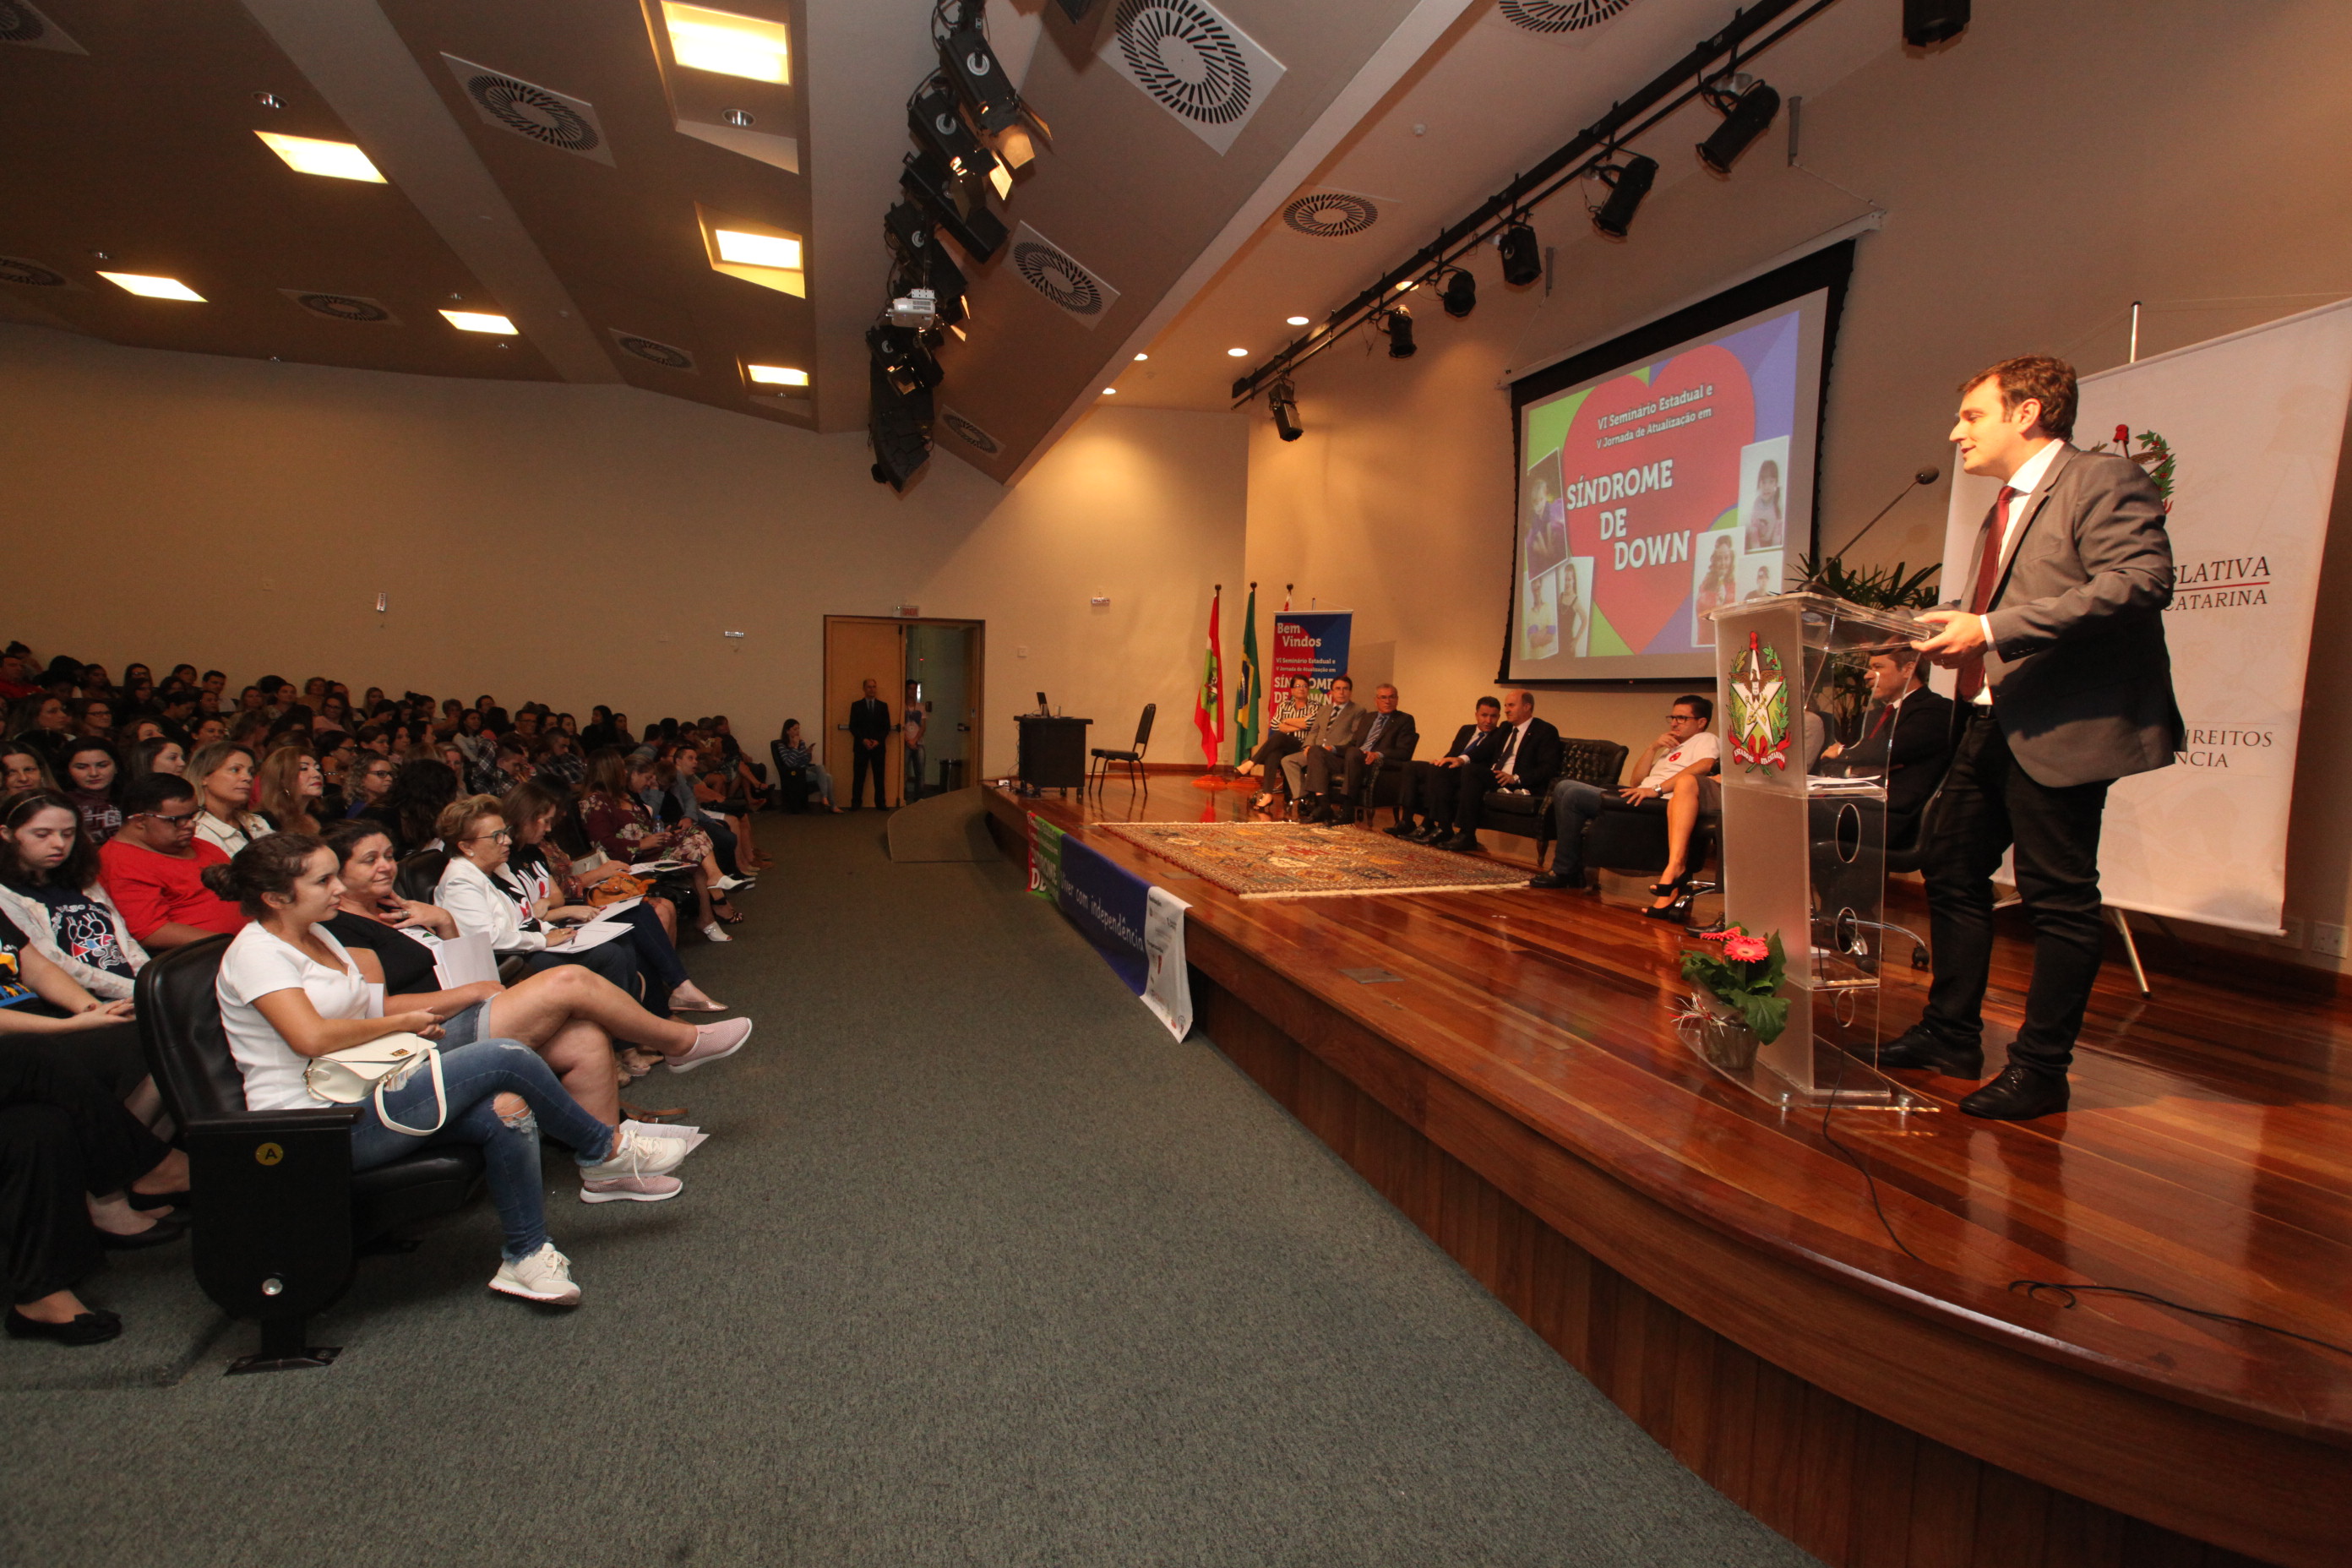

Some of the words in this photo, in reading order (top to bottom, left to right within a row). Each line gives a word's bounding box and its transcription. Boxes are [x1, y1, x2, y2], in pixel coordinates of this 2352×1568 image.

[1598, 416, 1607, 430] VI
[1609, 402, 1657, 427] Seminário
[1658, 384, 1703, 411] Estadual
[1706, 385, 1712, 395] e
[1596, 438, 1603, 449] V
[1603, 430, 1634, 447] Jornada
[1636, 427, 1645, 438] de
[1647, 413, 1696, 434] Atualização
[1697, 408, 1712, 419] em
[1566, 459, 1673, 510] SÍNDROME
[1599, 508, 1627, 540] DE
[1614, 530, 1690, 570] DOWN
[2173, 556, 2270, 585] LATIVA
[1277, 622, 1301, 634] Bem
[1282, 635, 1322, 647] Vindos
[1274, 691, 1289, 703] DE
[2185, 729, 2273, 747] IREITOS
[1076, 889, 1088, 909] com
[1091, 896, 1145, 953] independência
[265, 1149, 278, 1160] A
